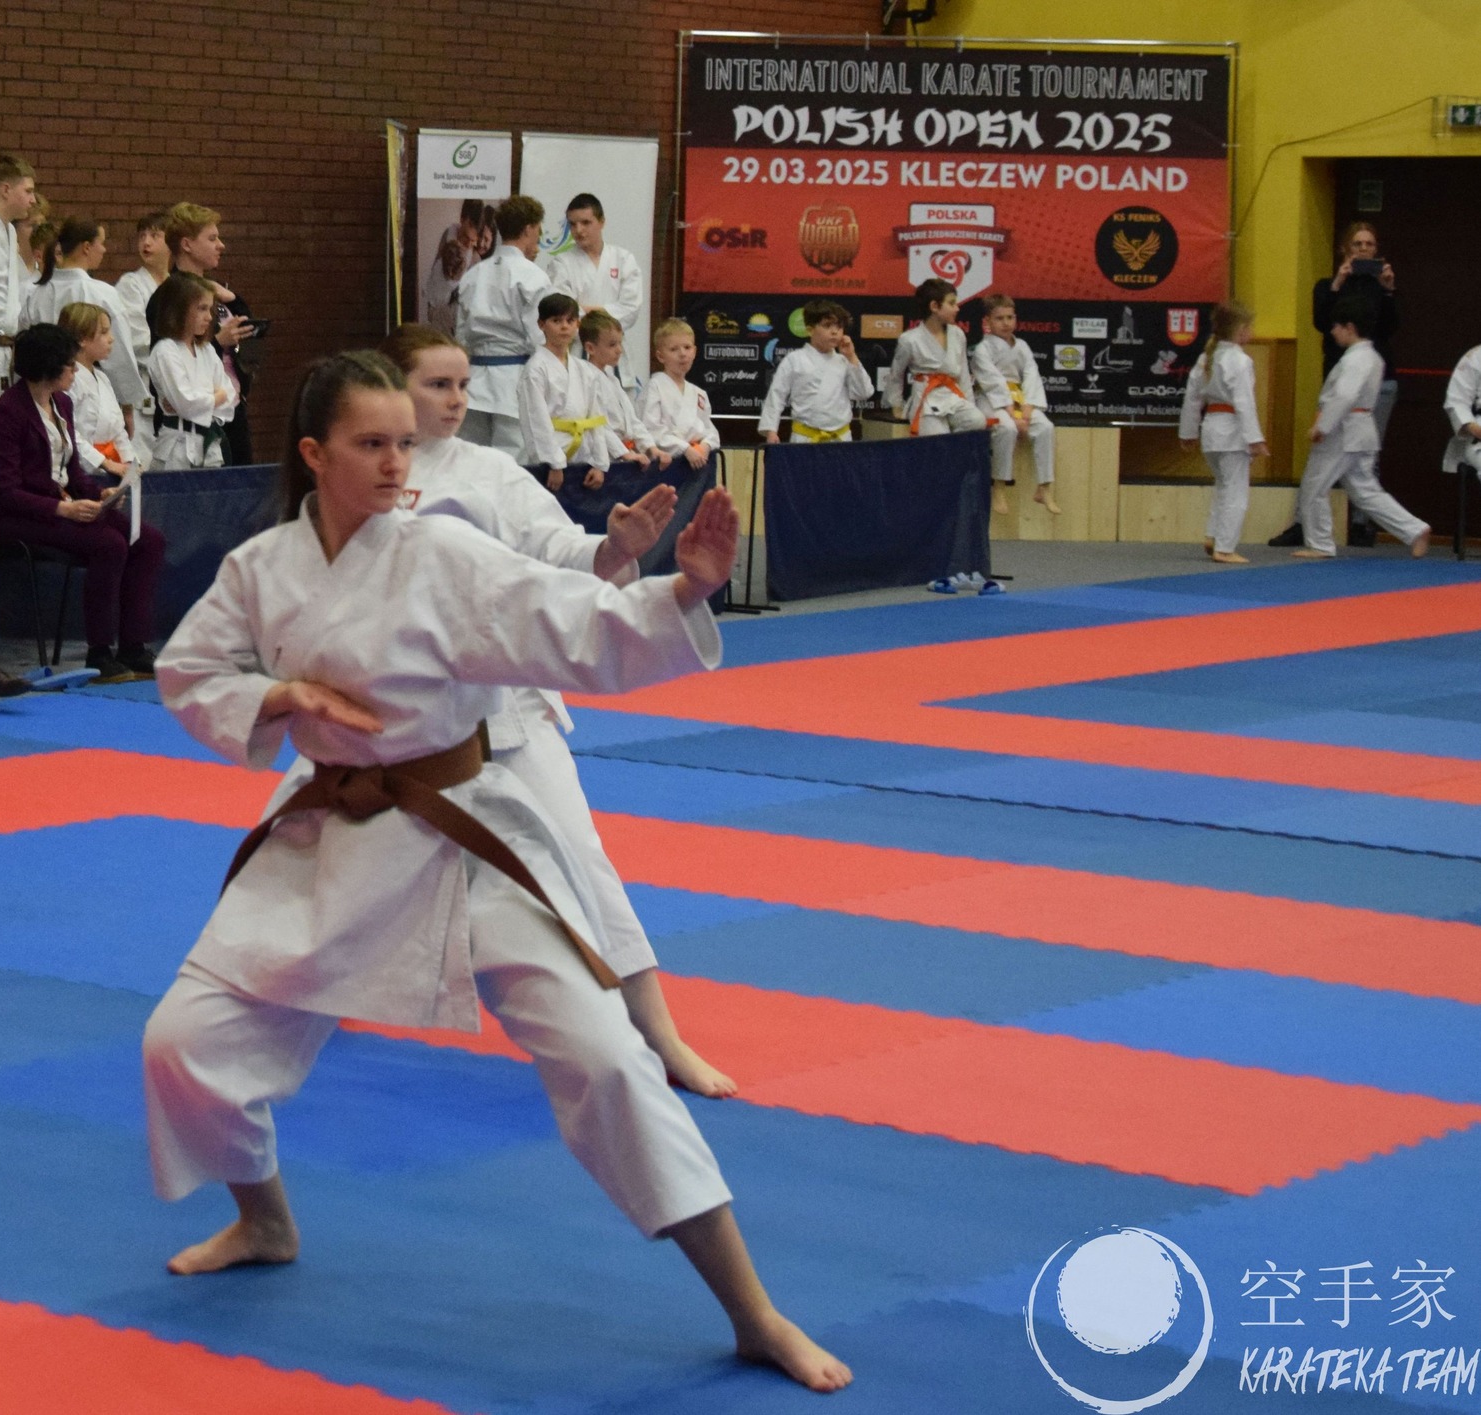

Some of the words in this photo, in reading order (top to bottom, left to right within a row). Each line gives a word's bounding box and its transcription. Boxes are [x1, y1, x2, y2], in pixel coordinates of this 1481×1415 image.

[705, 58, 911, 95] INTERNATIONAL
[922, 63, 1021, 97] KARATE
[1029, 65, 1207, 101] TOURNAMENT
[732, 104, 903, 145] POLISH
[914, 109, 1046, 149] OPEN
[1055, 111, 1174, 152] 2025
[722, 156, 889, 186] 29.03.2025
[900, 162, 1046, 189] KLECZEW
[1056, 164, 1188, 193] POLAND
[927, 209, 977, 220] POLSKA
[799, 222, 859, 245] WORLD
[898, 230, 926, 242] POLSKIE
[979, 232, 1005, 243] KARATE
[1113, 274, 1158, 283] KLECZEW
[730, 396, 753, 407] Salon
